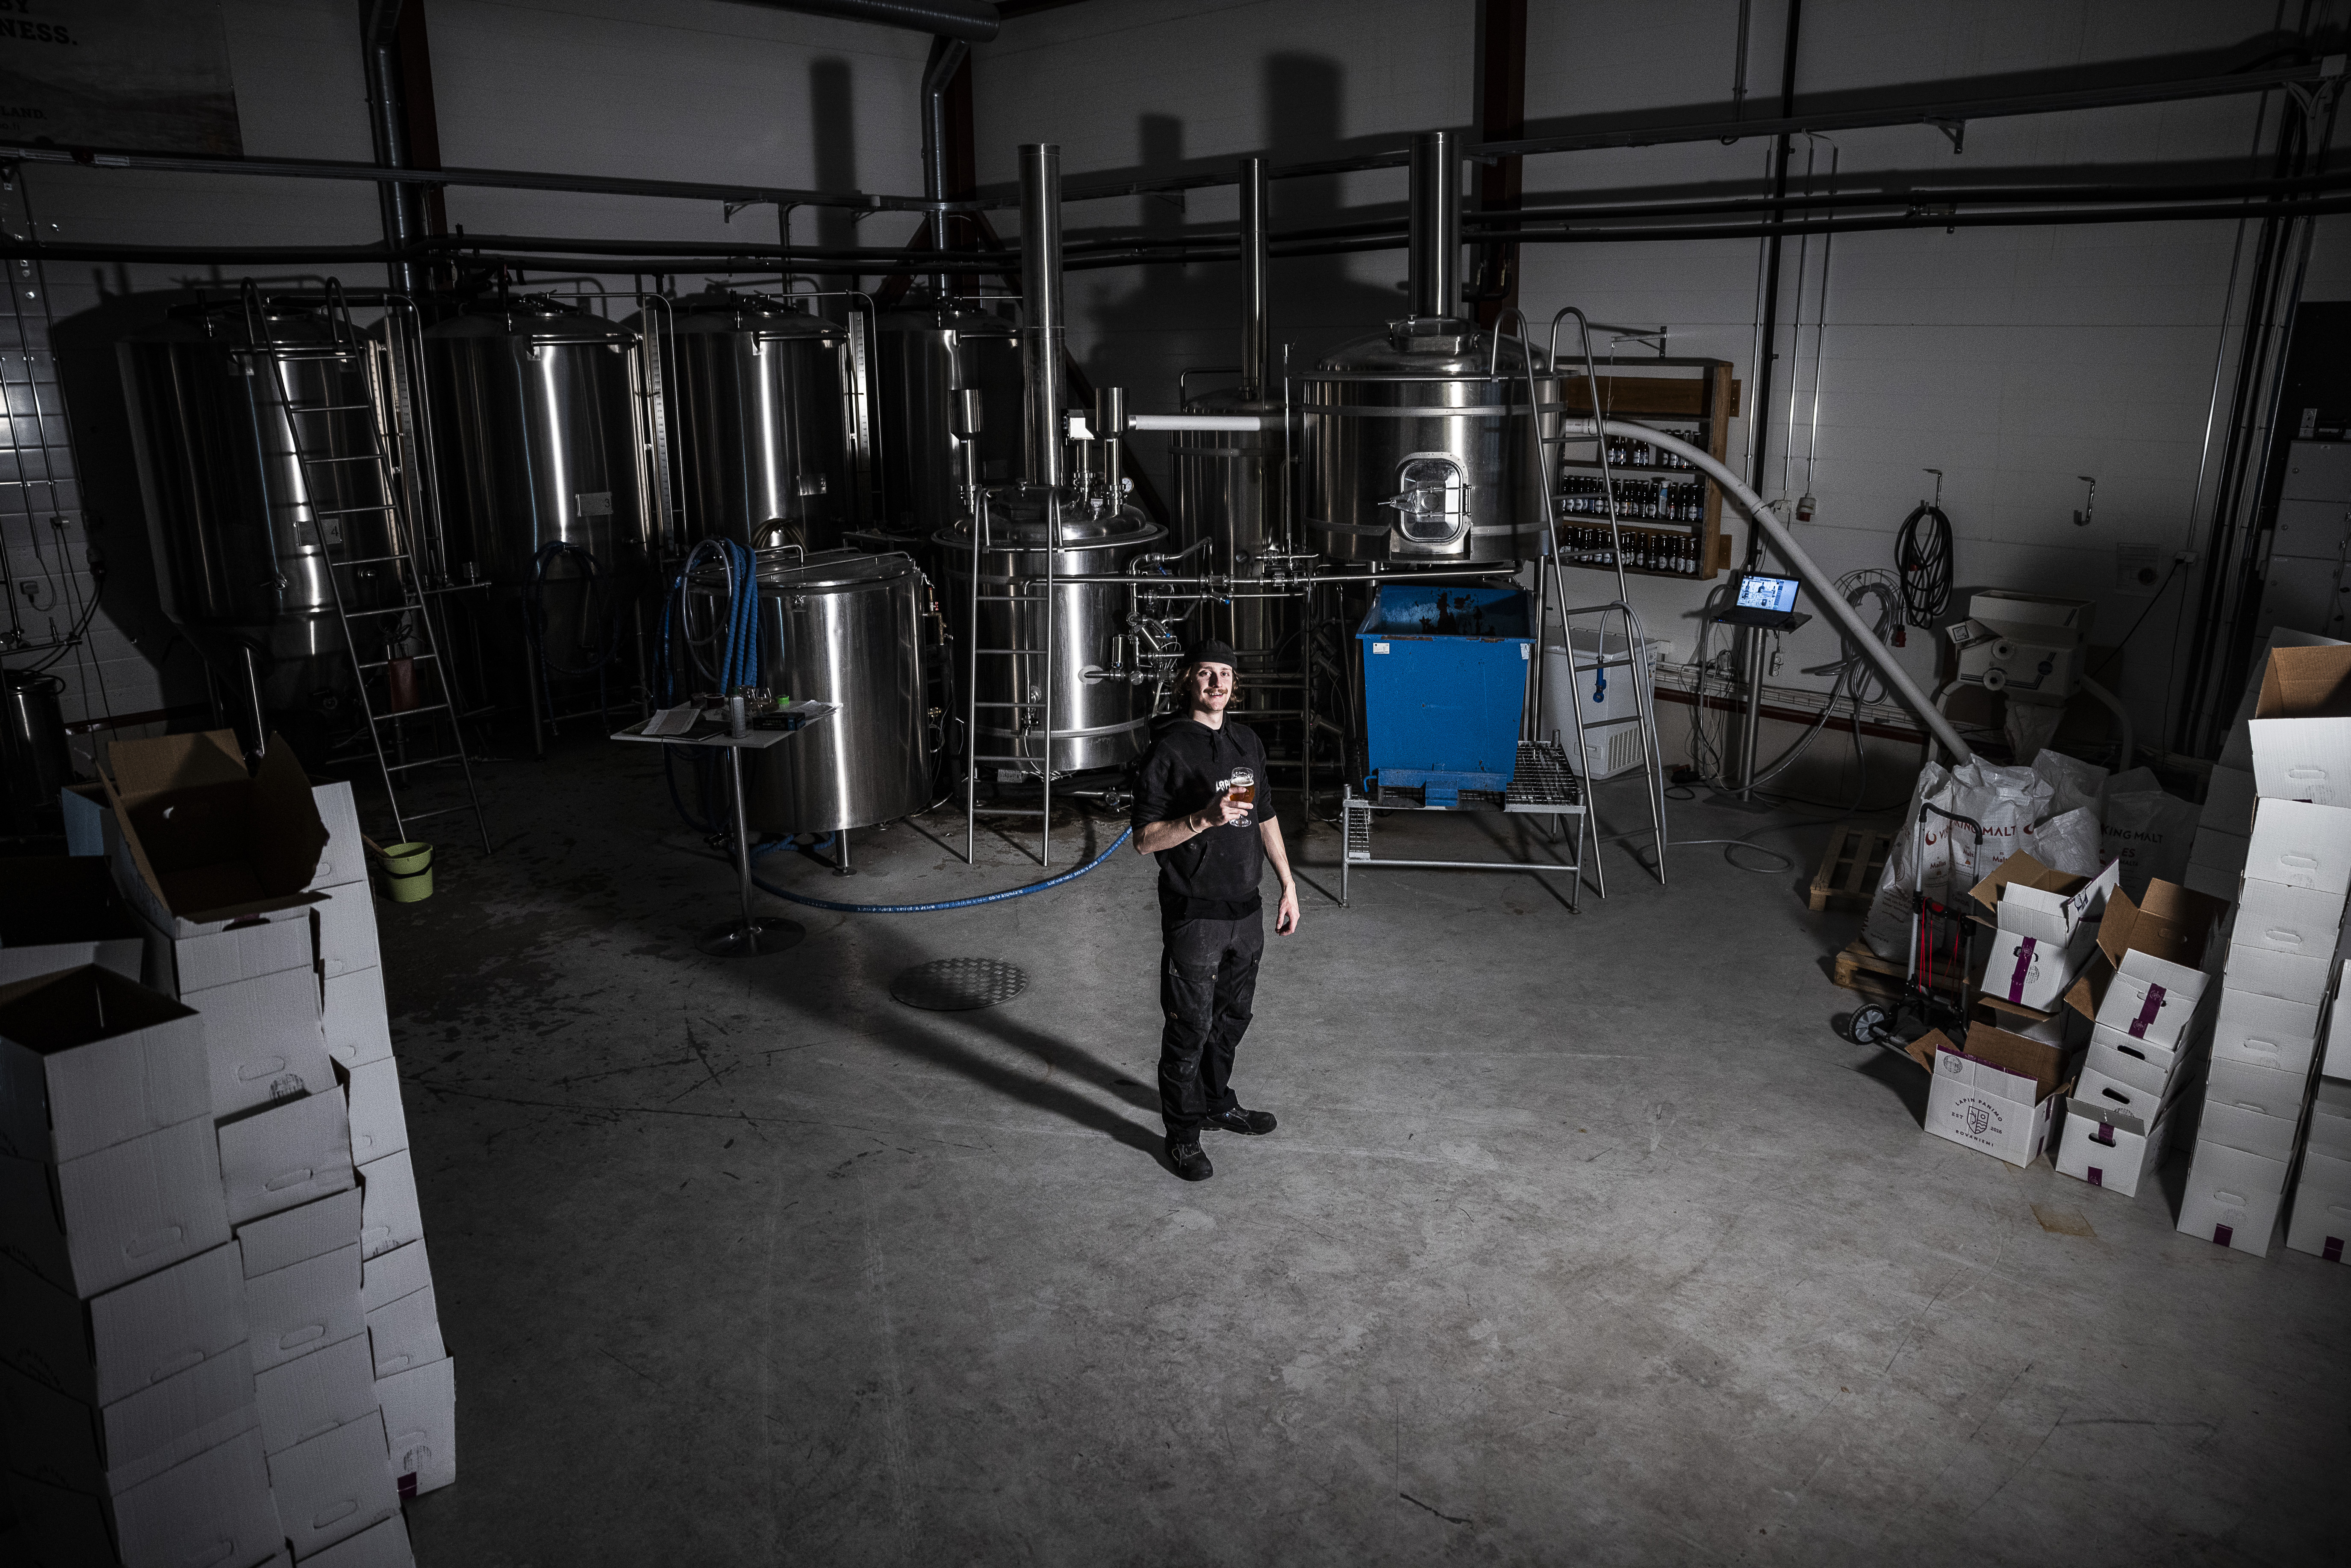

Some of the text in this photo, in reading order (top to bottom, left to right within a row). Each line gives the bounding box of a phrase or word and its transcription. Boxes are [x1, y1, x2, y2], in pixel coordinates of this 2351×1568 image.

[604, 498, 610, 507] 3
[331, 526, 338, 536] 4
[1216, 778, 1231, 793] LAPI
[1983, 825, 2016, 837] MALT
[2134, 832, 2163, 844] MALT
[2121, 848, 2136, 858] ES
[1978, 1099, 2003, 1122] PANIMO
[1956, 1130, 1993, 1147] ROVANIEMI
